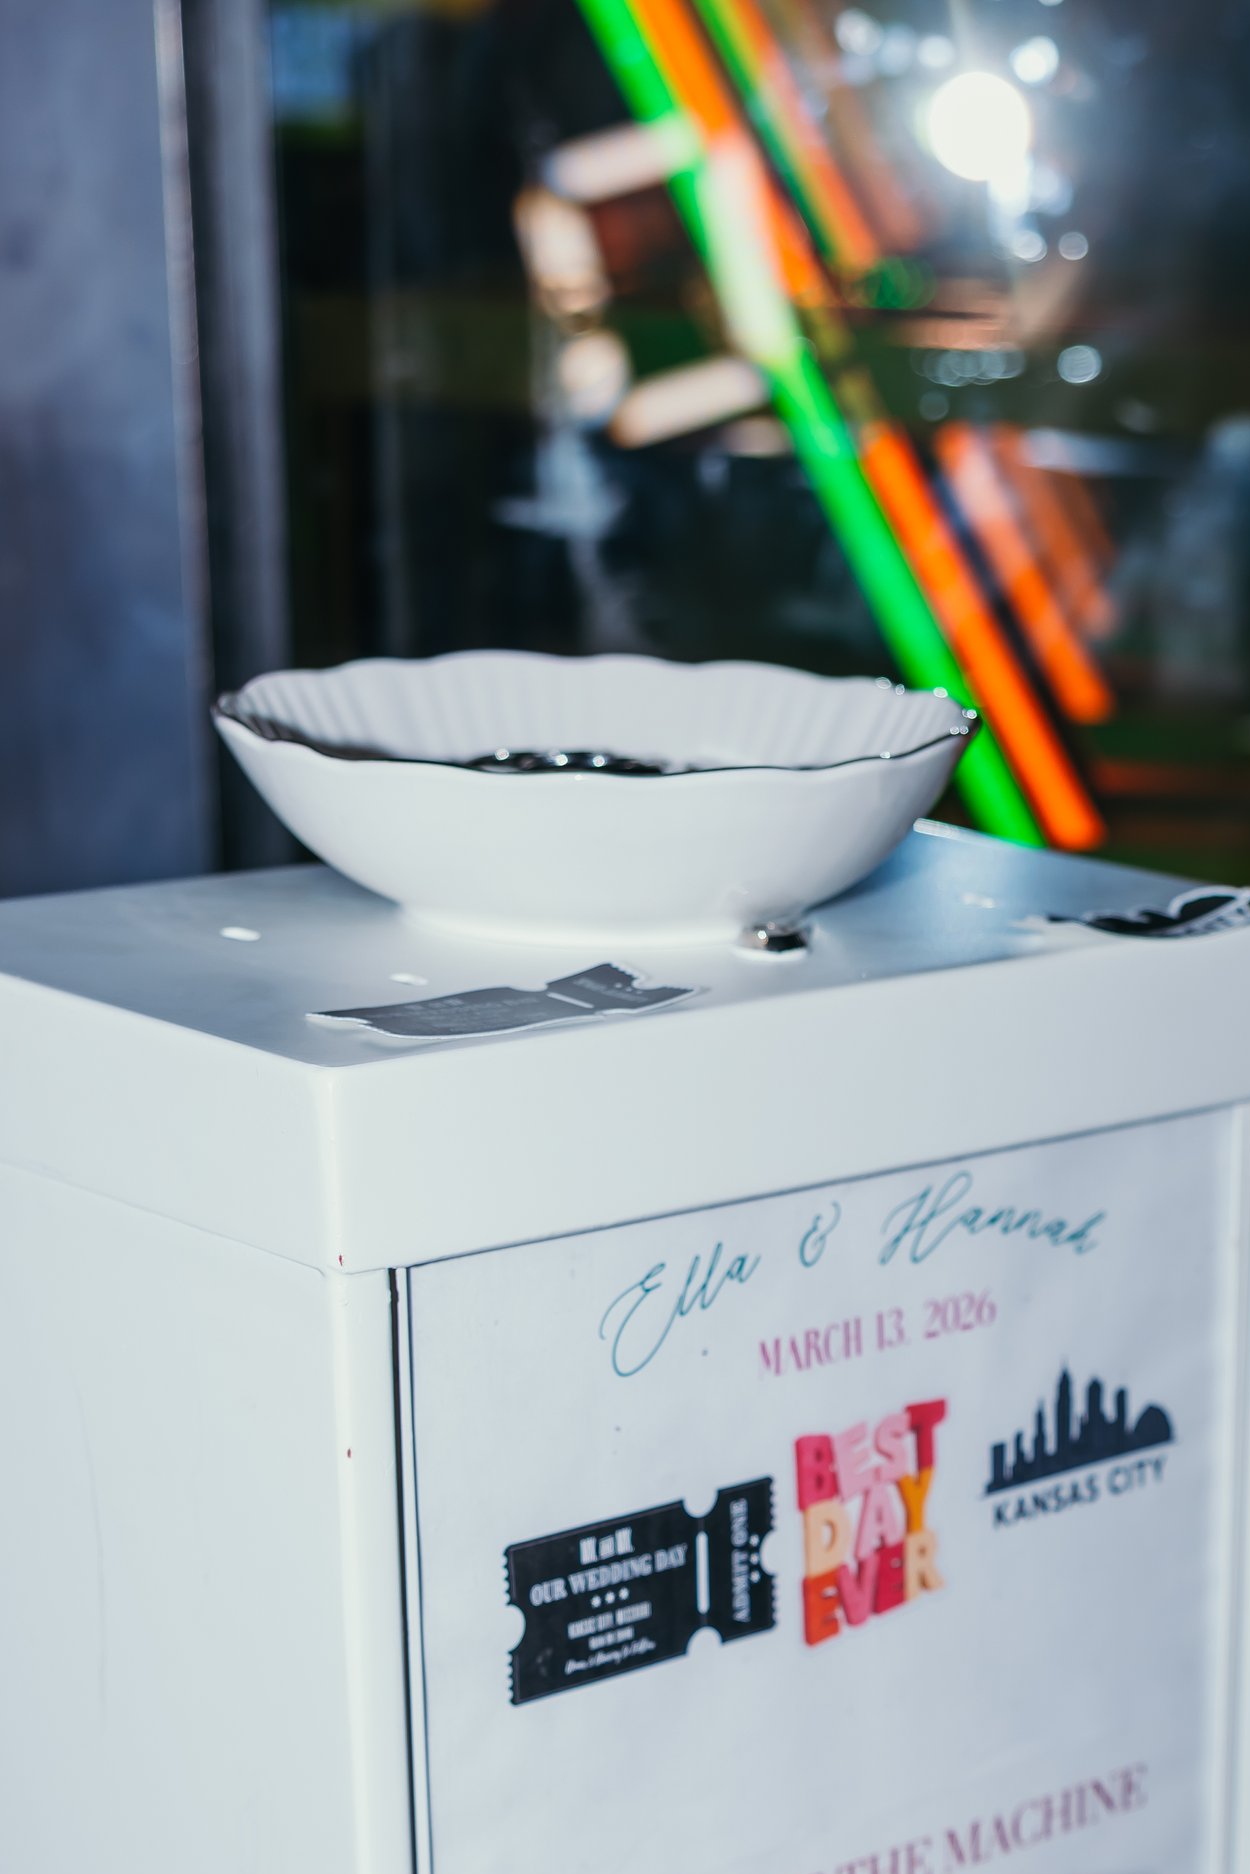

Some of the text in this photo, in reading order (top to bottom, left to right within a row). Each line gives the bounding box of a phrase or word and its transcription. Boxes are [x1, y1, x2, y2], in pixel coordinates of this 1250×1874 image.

[599, 1170, 1106, 1378] Ella & Hannah
[757, 1316, 863, 1380] MARCH
[922, 1288, 998, 1340] 2026
[795, 1398, 947, 1512] BEST
[992, 1454, 1168, 1529] KANSAS CITY
[529, 1576, 568, 1607] OUR
[567, 1552, 654, 1596] WEDDING
[653, 1542, 688, 1572] DAY
[730, 1497, 751, 1623] ADMIT ONE
[803, 1466, 935, 1580] DAY
[803, 1530, 945, 1646] EVER
